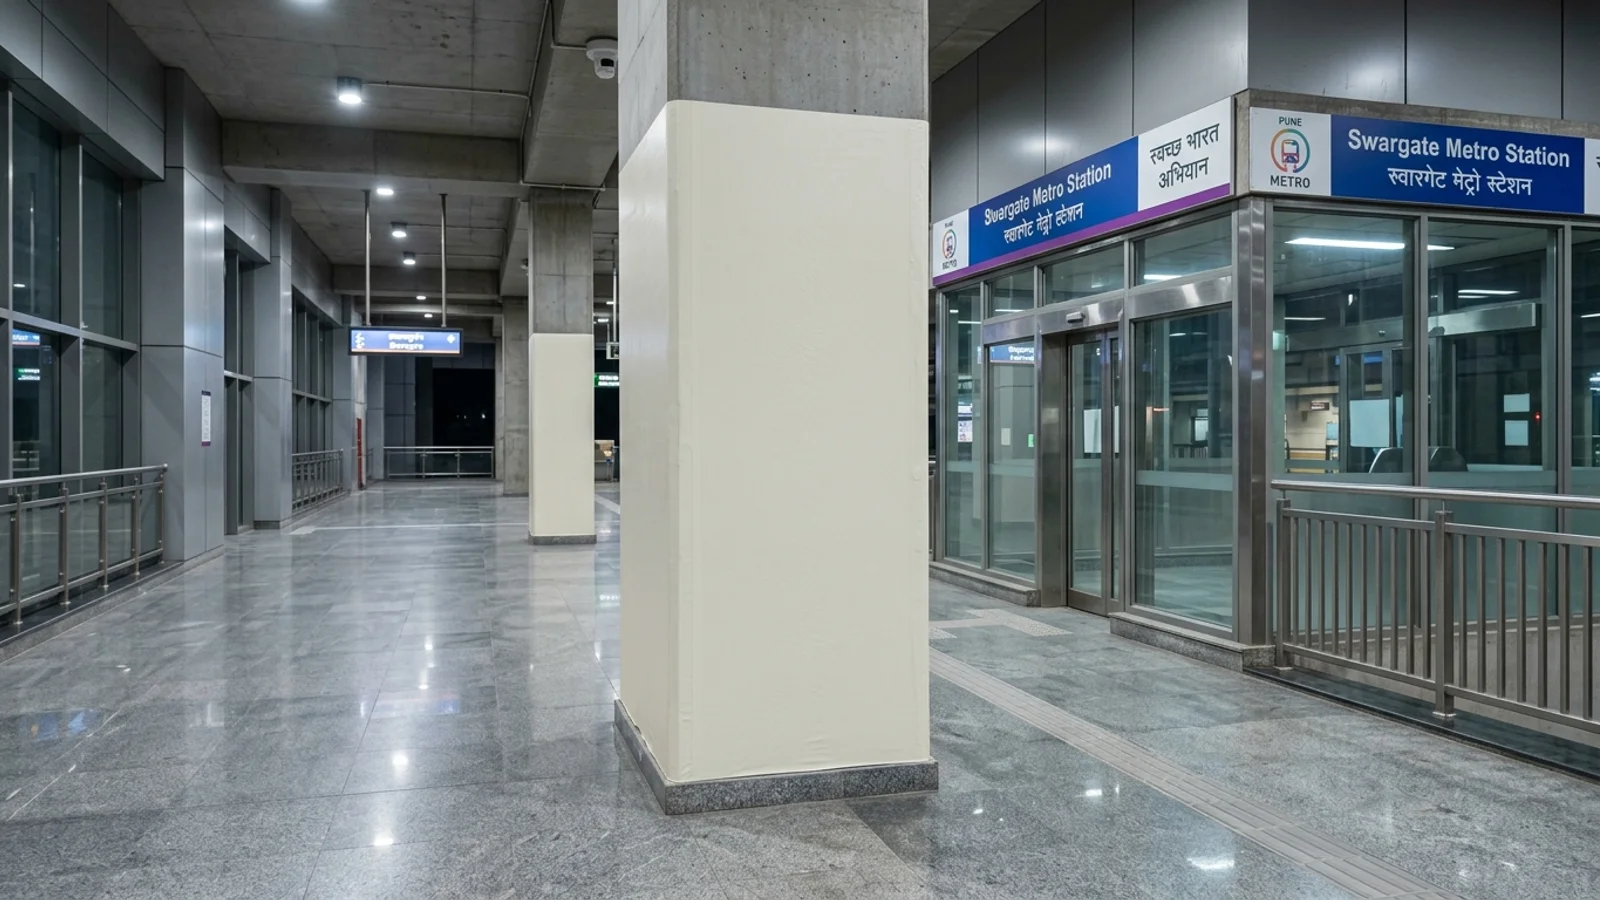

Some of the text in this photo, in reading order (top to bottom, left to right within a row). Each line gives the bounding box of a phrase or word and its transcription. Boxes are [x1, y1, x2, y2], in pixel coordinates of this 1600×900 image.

[1278, 115, 1302, 127] PUNE
[1149, 123, 1220, 165] स्वच्छ भारत
[1347, 128, 1440, 159] Swargate
[1446, 137, 1500, 162] Metro
[1505, 142, 1570, 168] Station
[1158, 157, 1209, 188] अभियान
[1269, 174, 1311, 189] METRO
[1387, 164, 1533, 196] स्वारगेट मेट्रो स्टेशन
[984, 163, 1111, 226] Swargate Metro Station
